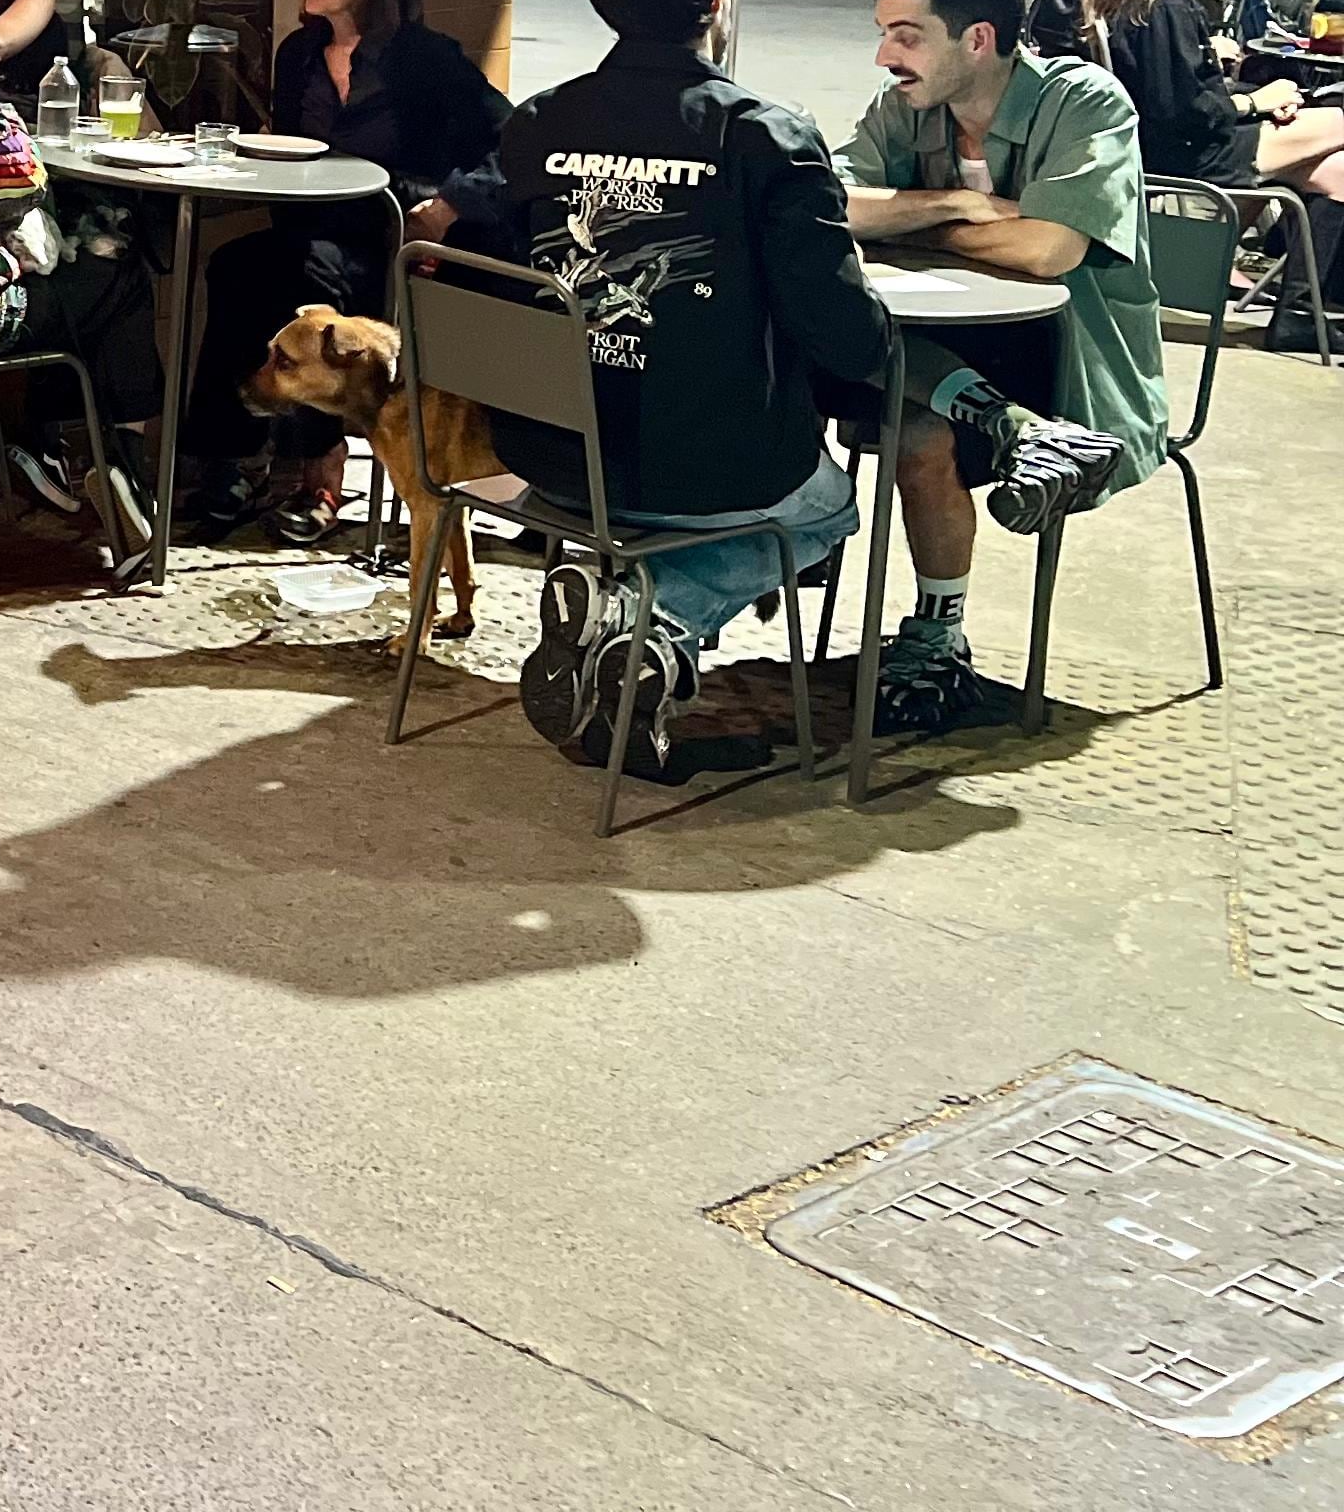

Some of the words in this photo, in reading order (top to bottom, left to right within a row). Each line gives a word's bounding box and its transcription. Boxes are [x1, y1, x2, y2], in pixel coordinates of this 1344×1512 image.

[582, 176, 635, 197] WORK
[636, 180, 658, 197] IN
[693, 282, 713, 299] 89
